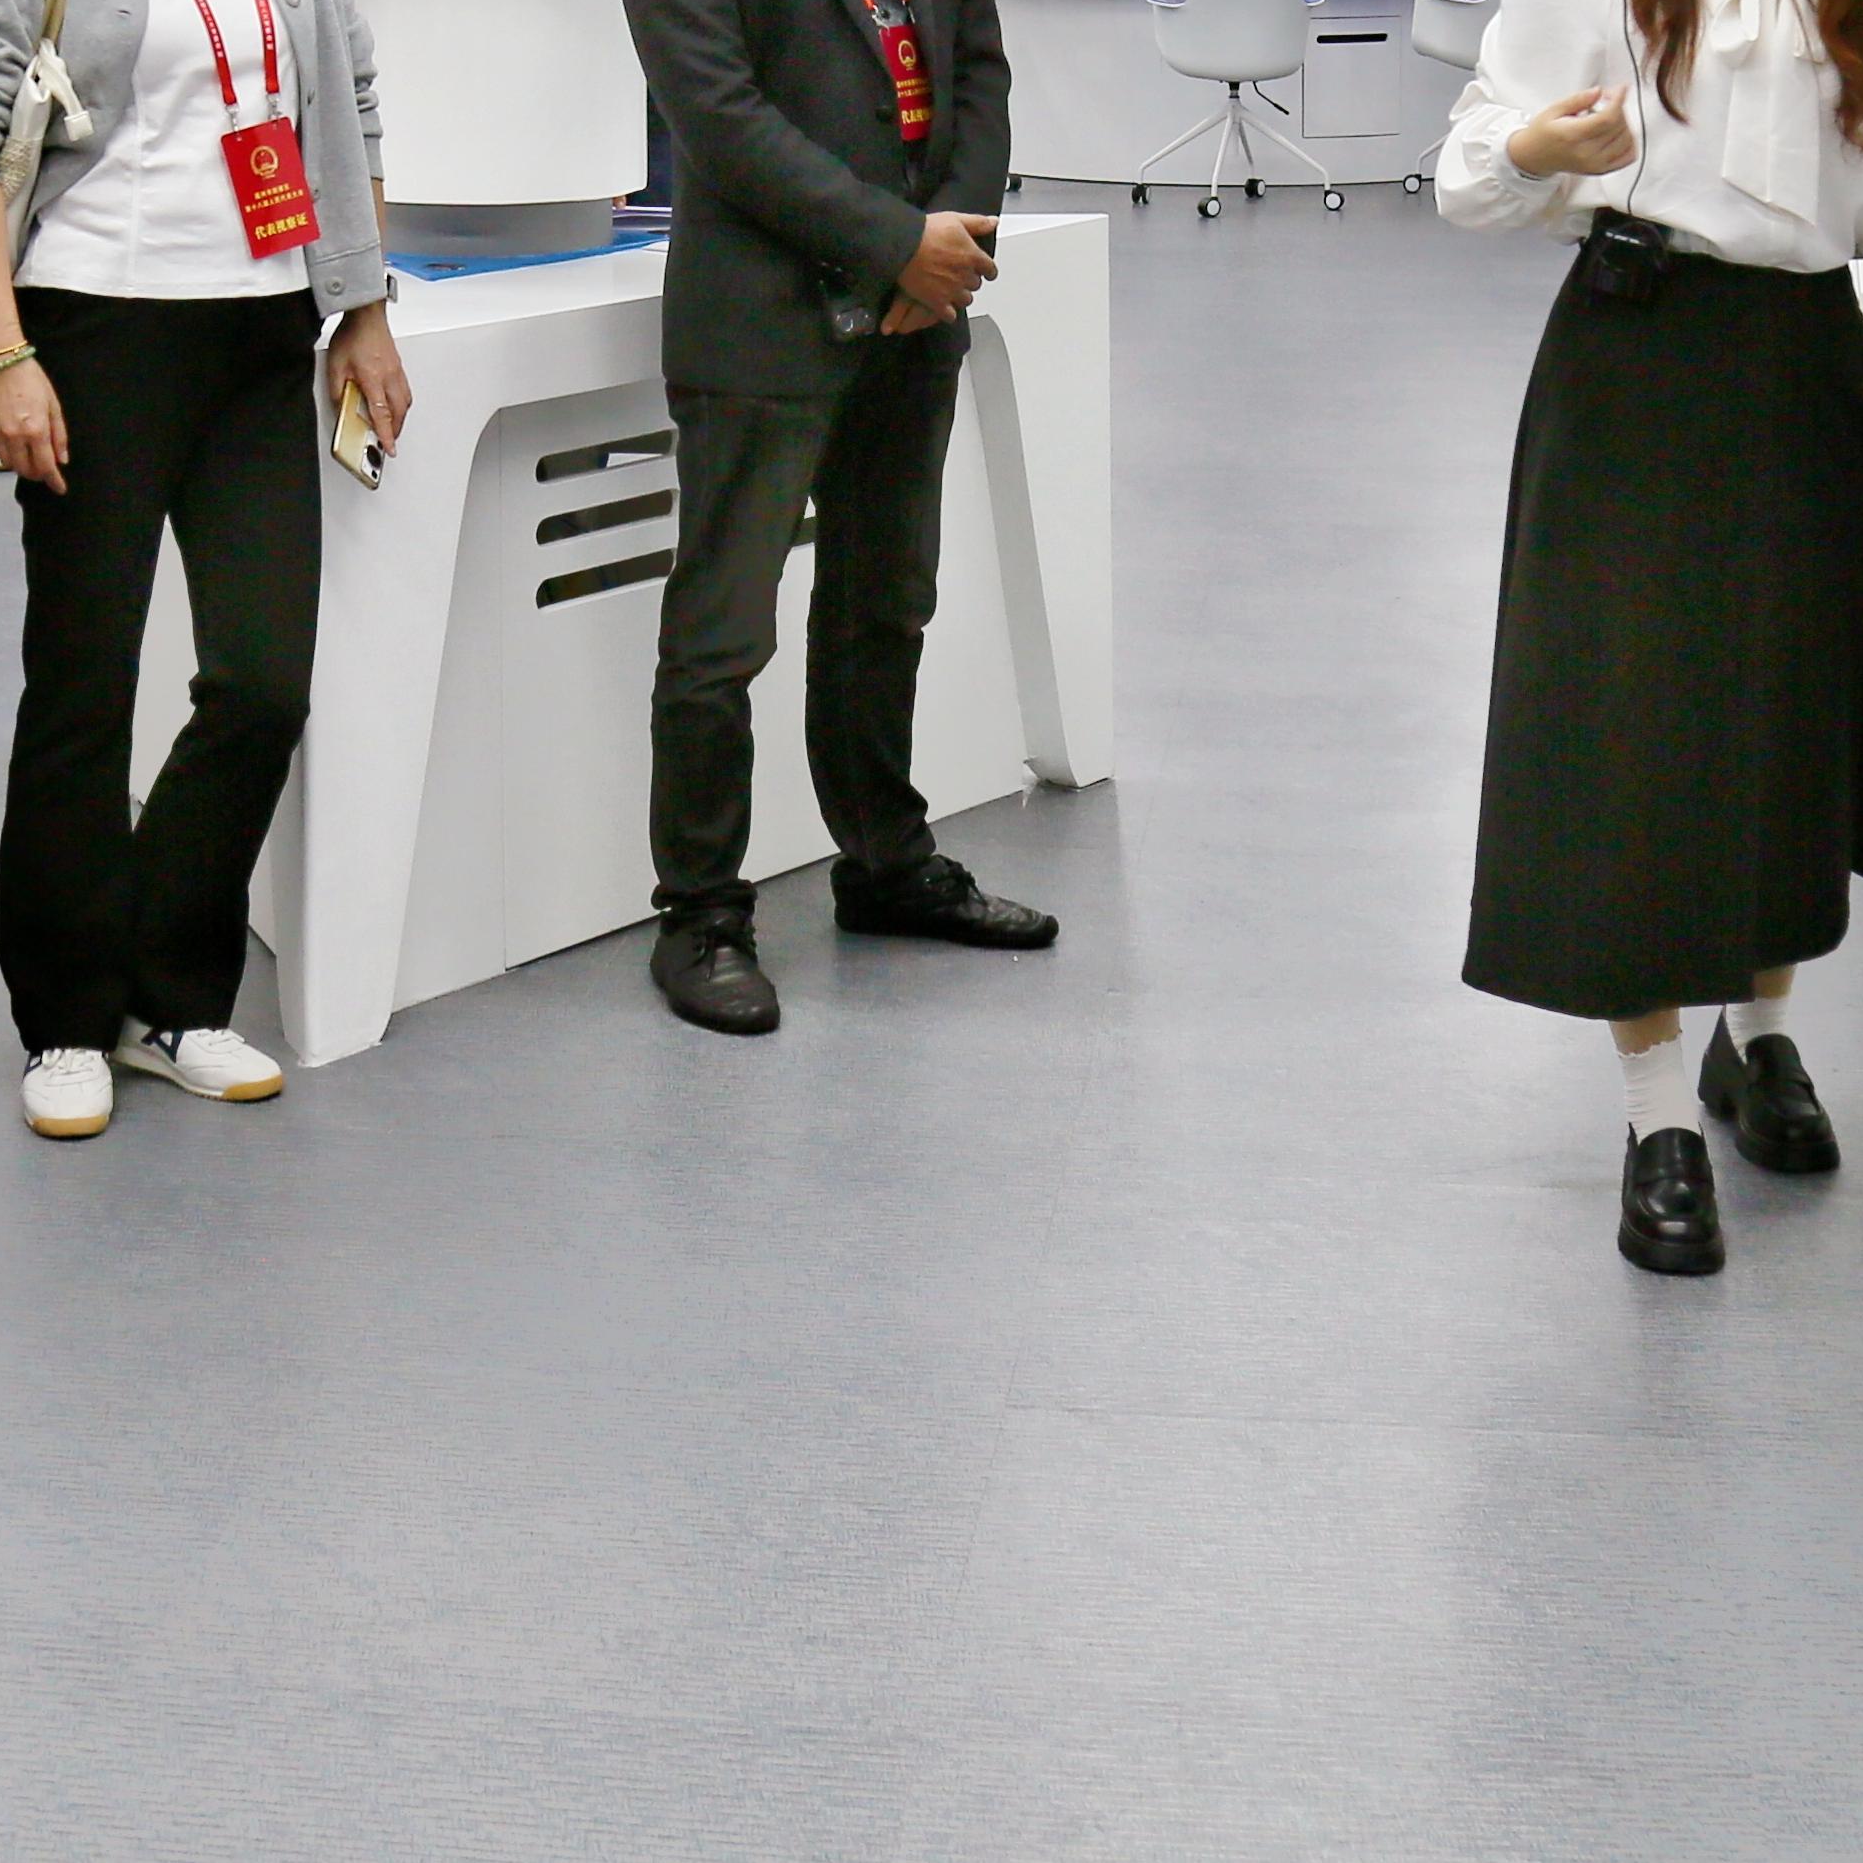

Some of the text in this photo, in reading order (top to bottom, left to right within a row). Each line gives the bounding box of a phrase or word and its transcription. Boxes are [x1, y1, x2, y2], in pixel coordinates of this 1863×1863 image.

[255, 212, 308, 240] 代表视察证
